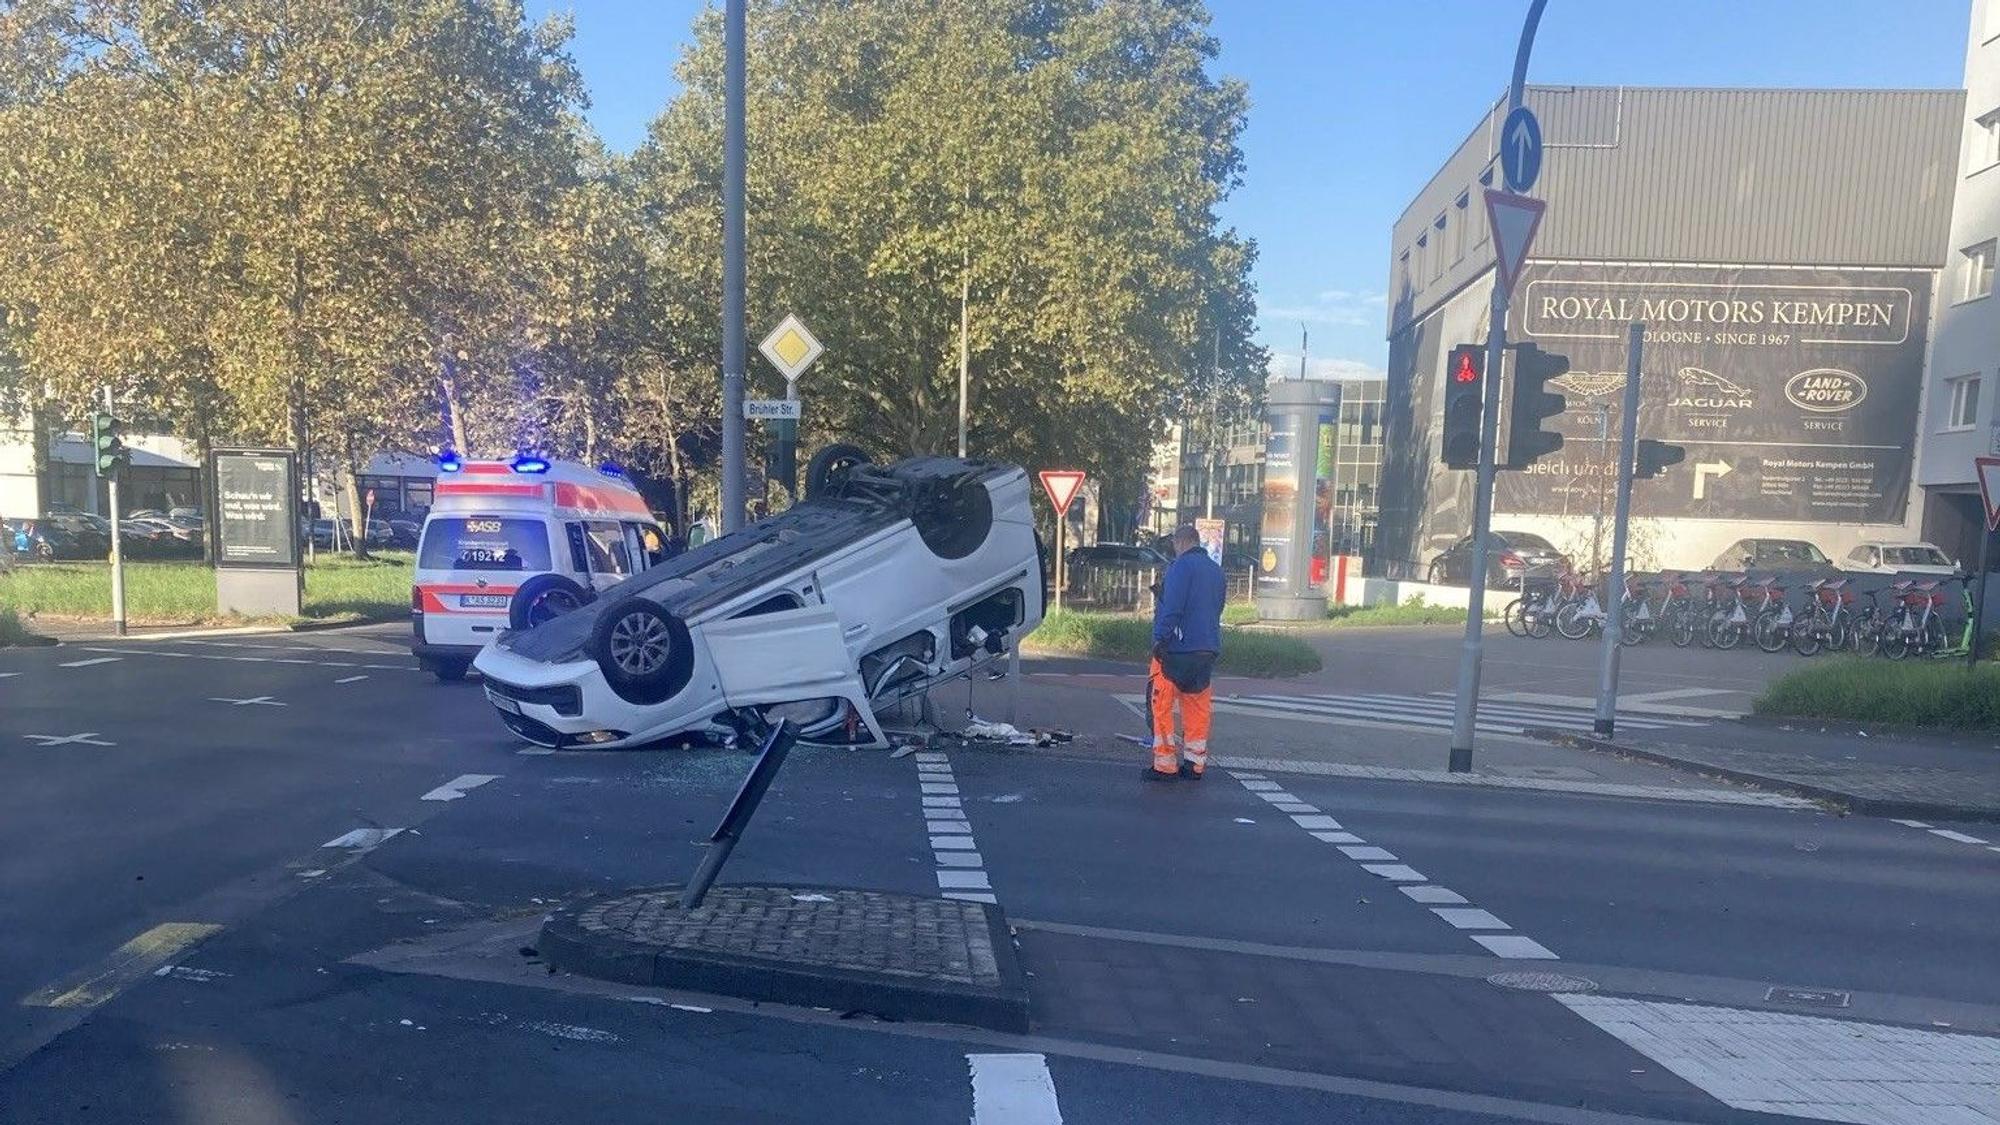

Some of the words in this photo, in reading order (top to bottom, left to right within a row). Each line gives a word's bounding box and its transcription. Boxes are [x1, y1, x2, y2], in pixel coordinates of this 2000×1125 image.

[1542, 296, 1633, 321] ROYAL
[1642, 298, 1764, 324] MOTORS
[1772, 302, 1894, 327] KEMPEN
[1641, 332, 1701, 344] OLOGNE
[1714, 333, 1757, 345] SINCE
[1760, 333, 1791, 346] 1967
[781, 403, 794, 415] Str.
[1667, 397, 1753, 409] JAGUAR
[1688, 418, 1728, 428] SERVICE
[1804, 421, 1843, 431] SERVICE
[1762, 459, 1785, 469] Royal
[1786, 460, 1814, 468] Motors
[1815, 461, 1848, 470] Kempen
